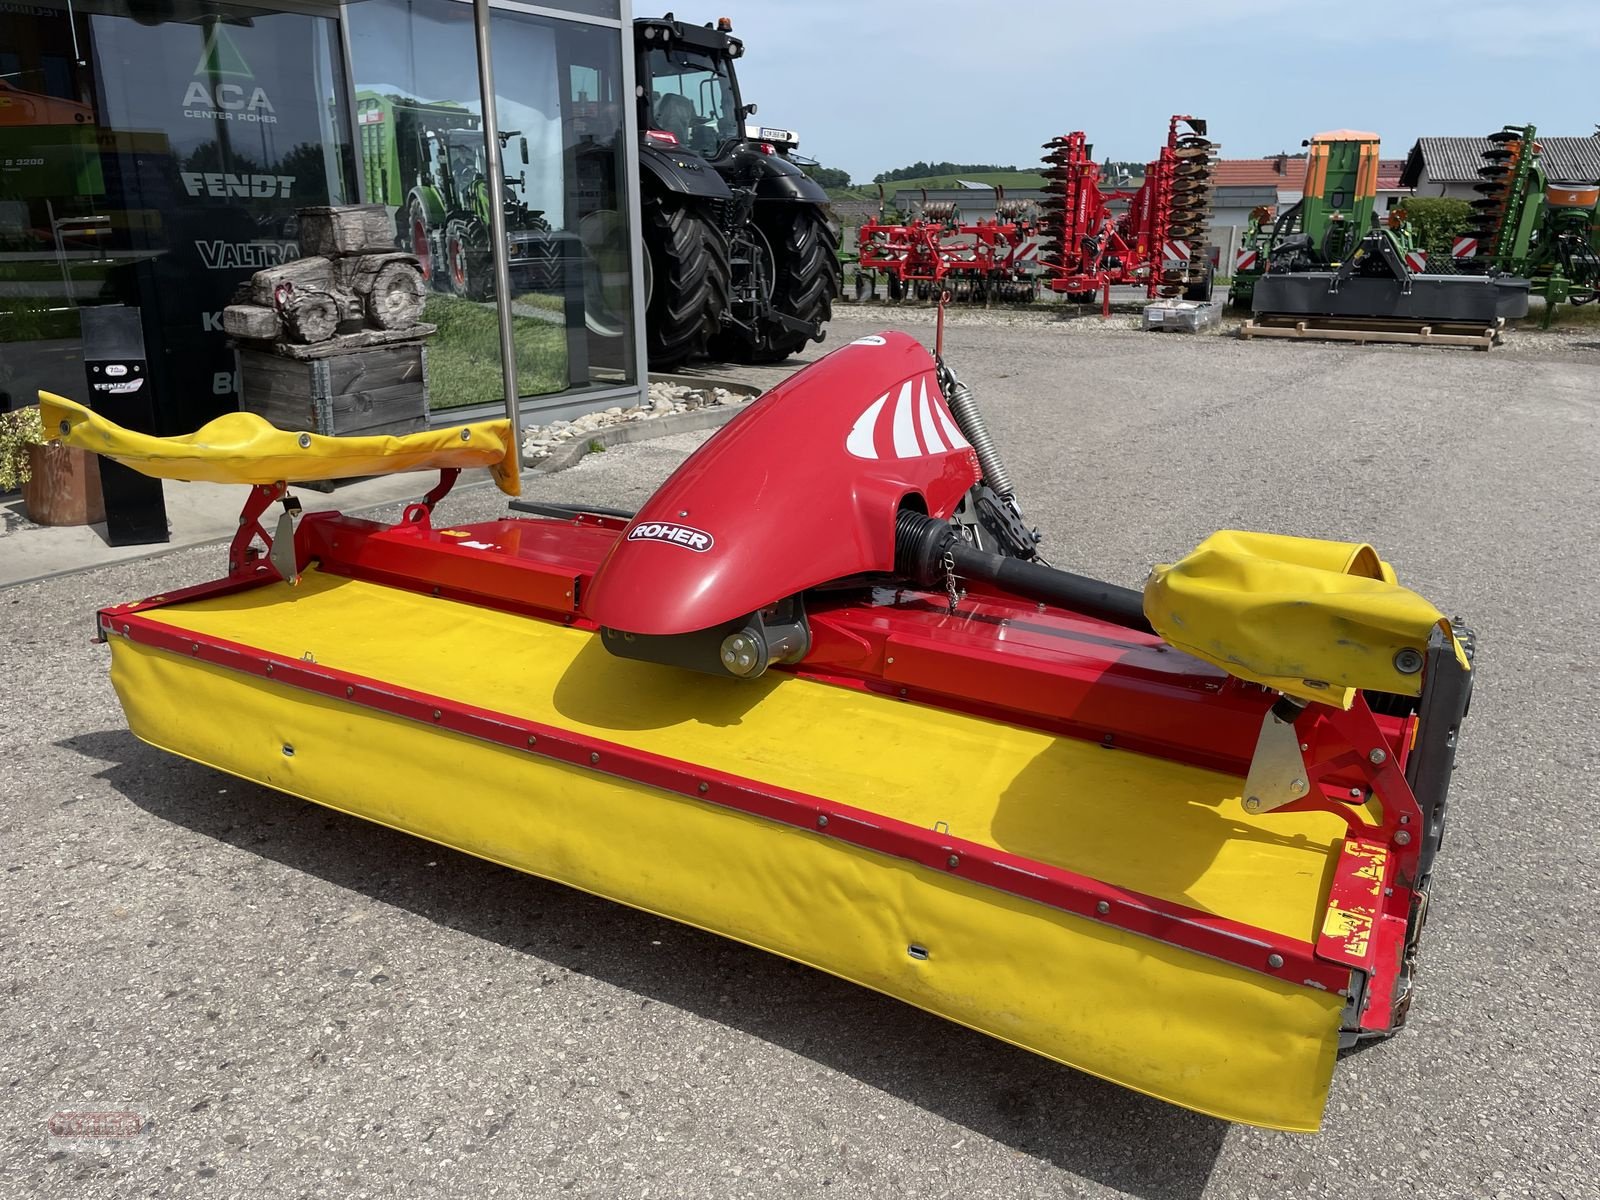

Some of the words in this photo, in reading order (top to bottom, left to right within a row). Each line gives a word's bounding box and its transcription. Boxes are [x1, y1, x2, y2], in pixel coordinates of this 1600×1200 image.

[182, 82, 276, 113] ACA
[183, 110, 234, 120] CENTER
[238, 113, 278, 124] ROHER
[180, 172, 296, 198] FENDT
[630, 524, 709, 549] ROHER
